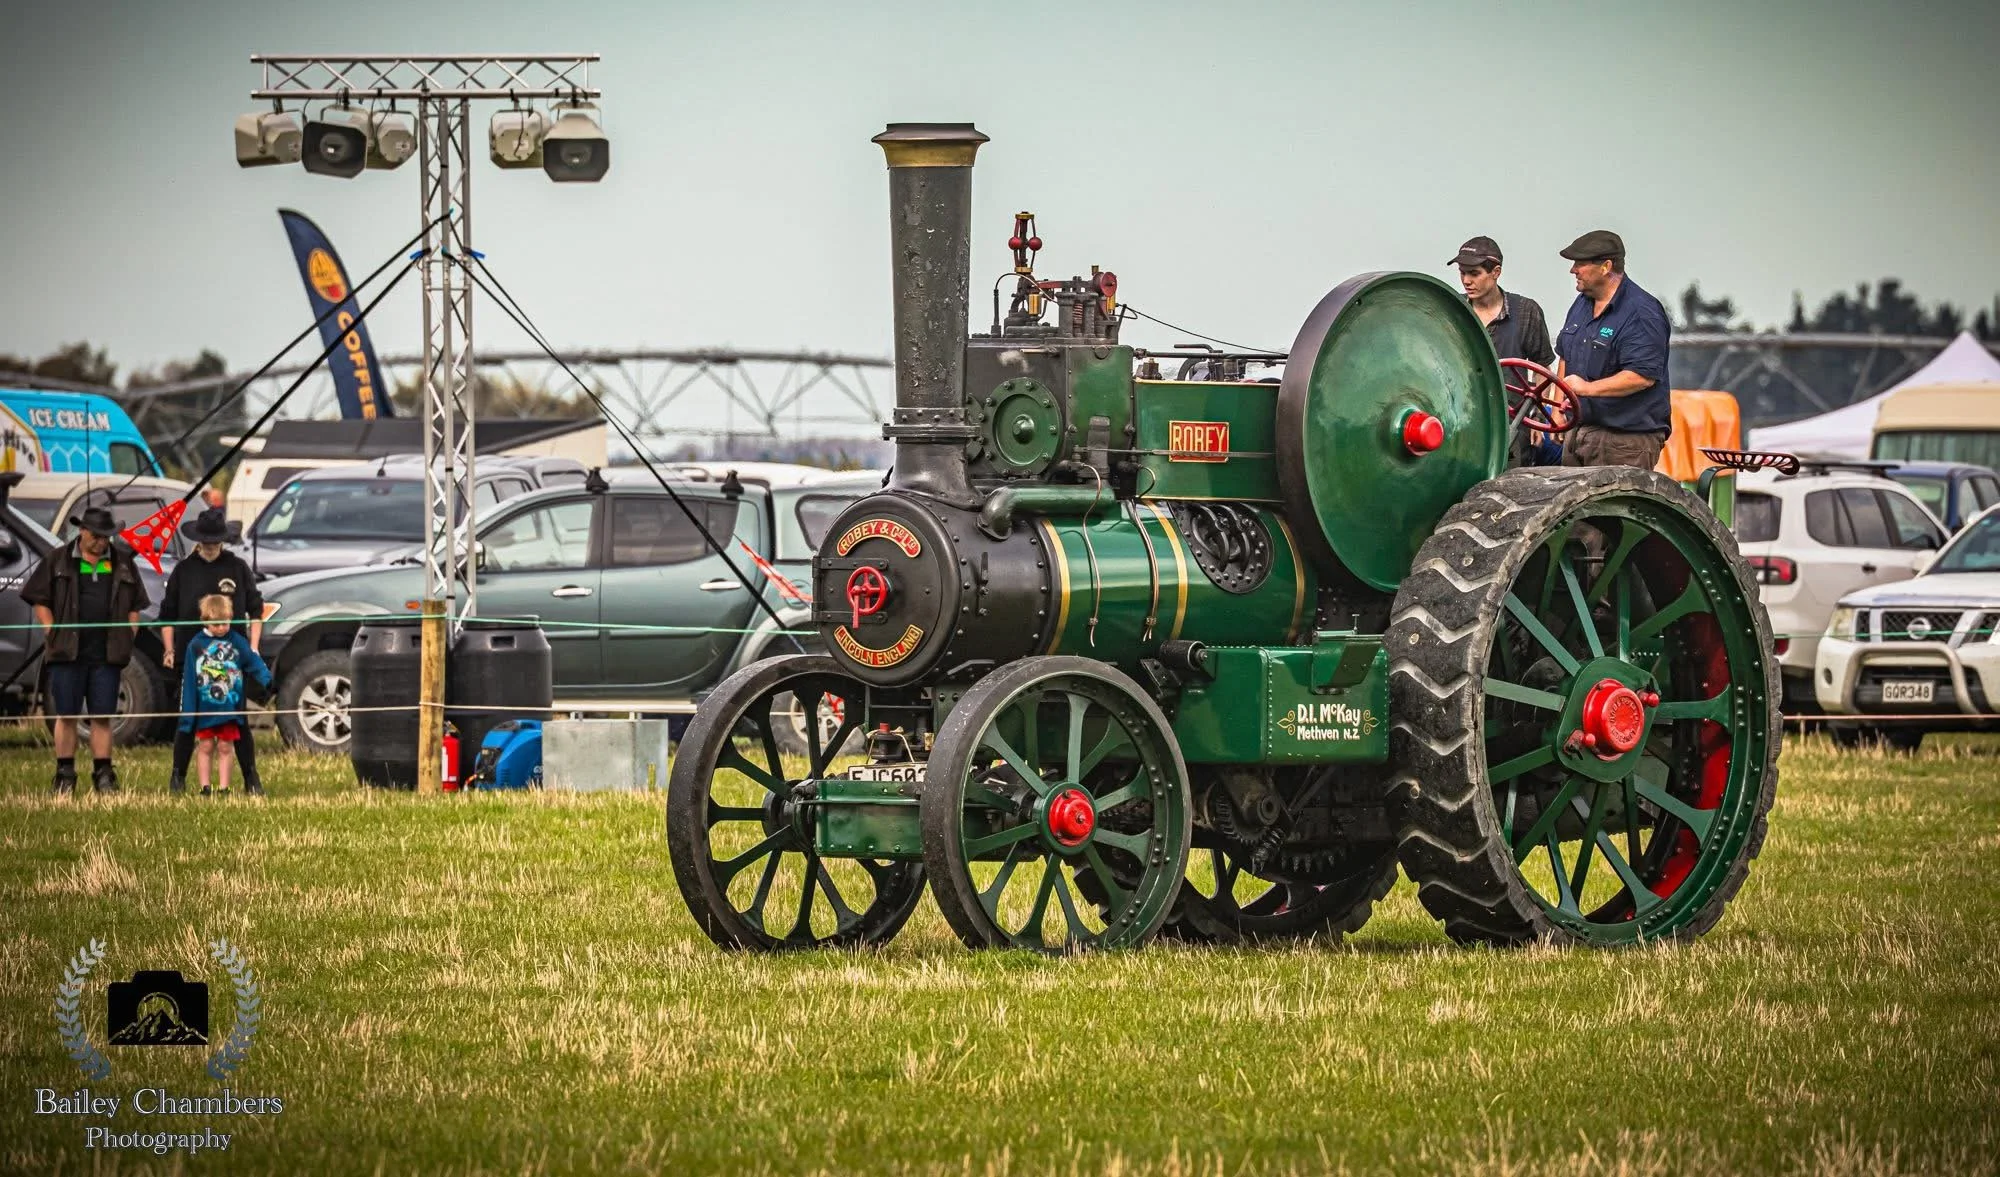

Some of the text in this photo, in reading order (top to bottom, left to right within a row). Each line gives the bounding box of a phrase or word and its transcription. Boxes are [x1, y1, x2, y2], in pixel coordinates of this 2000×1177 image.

[337, 310, 377, 421] COFFEE
[28, 408, 111, 431] ICE CREAM
[1172, 425, 1227, 454] ROBEY
[841, 521, 878, 551] ROBEY
[880, 522, 889, 535] &
[836, 627, 921, 665] LINCOLN ENGLAND
[1296, 703, 1361, 727] D.I. McKay
[1296, 725, 1361, 740] Methven N.Z.
